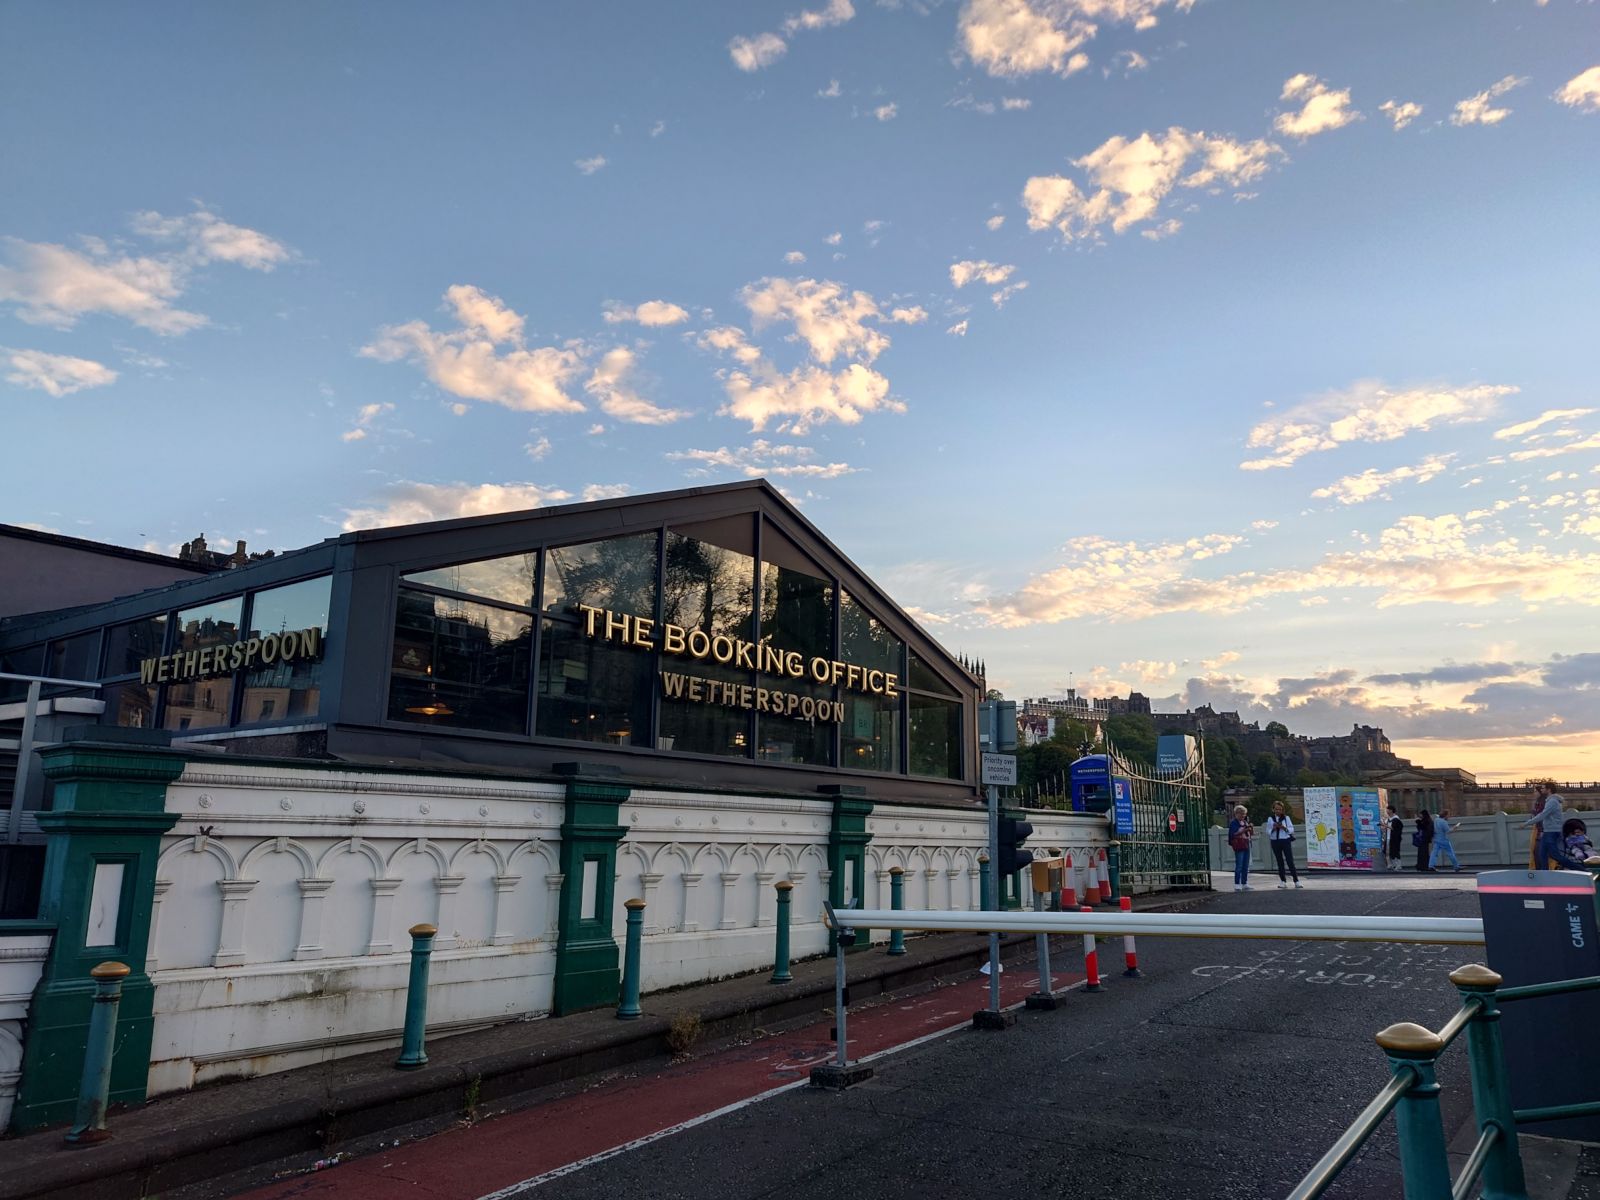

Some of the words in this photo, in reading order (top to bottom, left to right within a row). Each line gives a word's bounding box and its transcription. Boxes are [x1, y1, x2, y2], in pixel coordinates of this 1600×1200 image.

[139, 626, 322, 685] WETHERSPOON
[579, 602, 655, 651] THE
[664, 623, 804, 678] BOOKING
[810, 656, 898, 697] OFFICE
[663, 671, 846, 723] WETHERSPOON
[984, 755, 1003, 766] Priority
[988, 766, 1012, 775] oncoming
[989, 773, 1010, 782] vehicles
[1569, 915, 1585, 948] CAME
